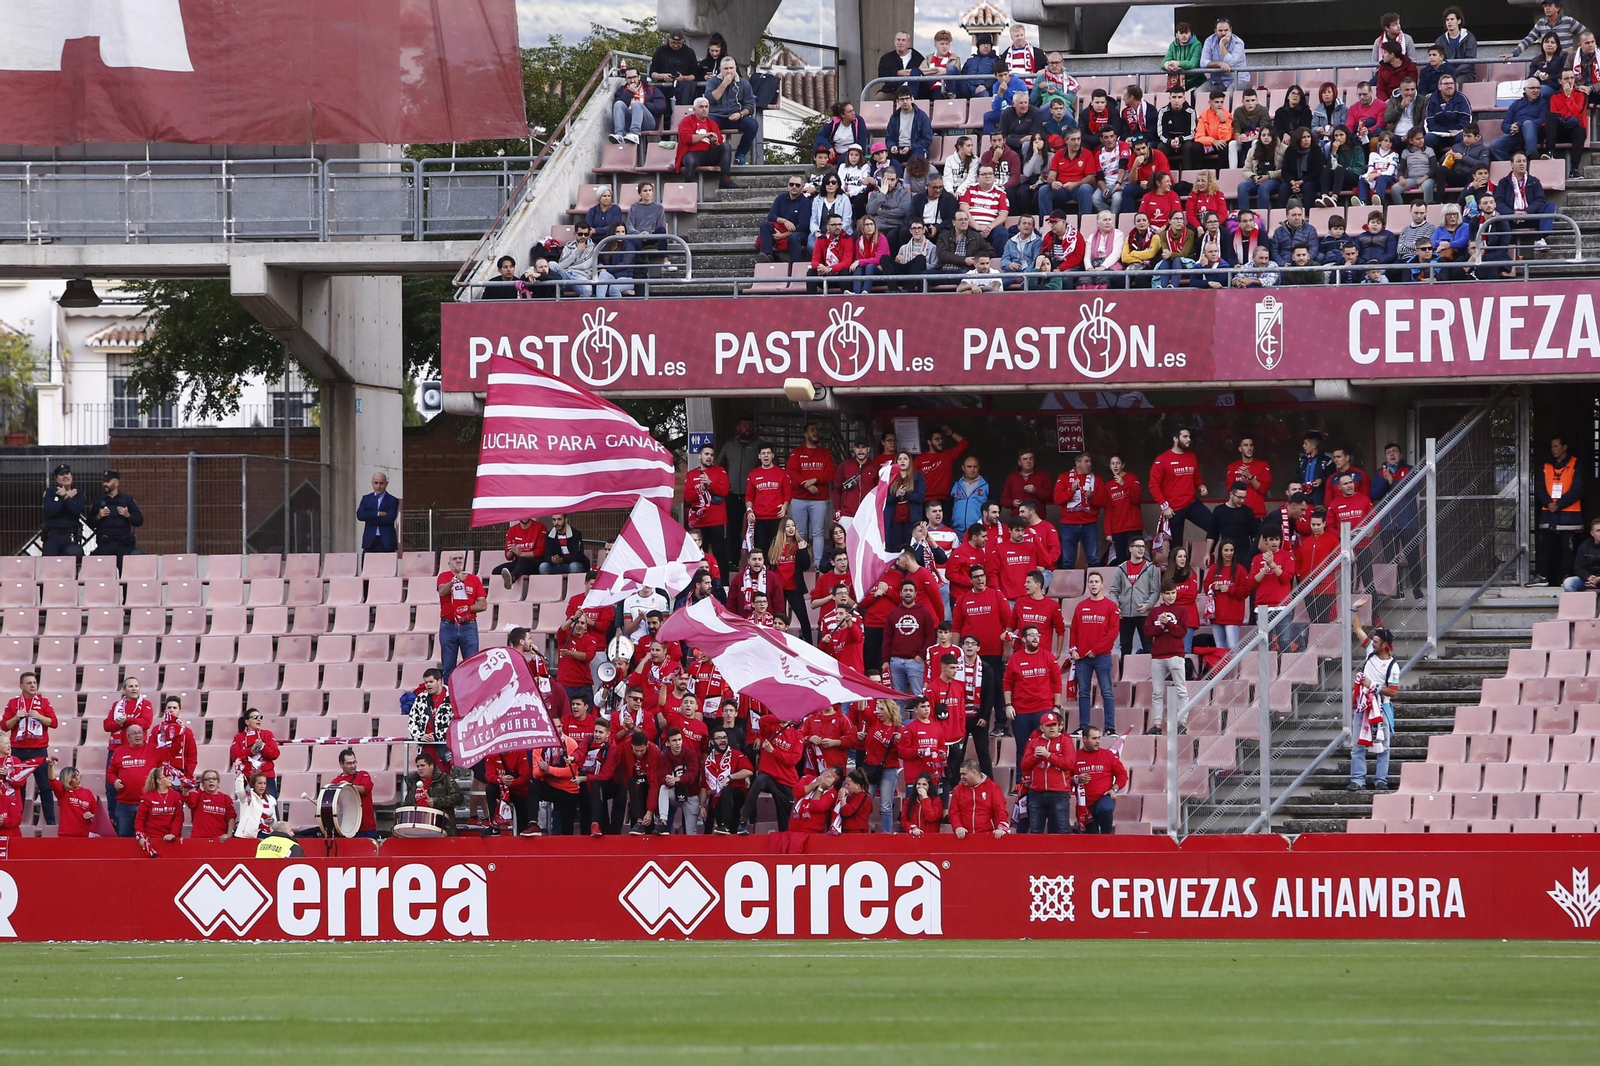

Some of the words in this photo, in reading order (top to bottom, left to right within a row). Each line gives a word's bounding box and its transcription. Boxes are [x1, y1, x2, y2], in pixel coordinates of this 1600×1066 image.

[1348, 293, 1600, 365] CERVEZA
[482, 433, 539, 450] LUCHAR
[547, 435, 597, 451] PARA
[605, 434, 666, 454] GANAR
[277, 863, 489, 937] errea
[724, 860, 944, 935] errea
[1091, 877, 1258, 919] CERVEZAS
[1271, 877, 1466, 918] ALHAMBRA
